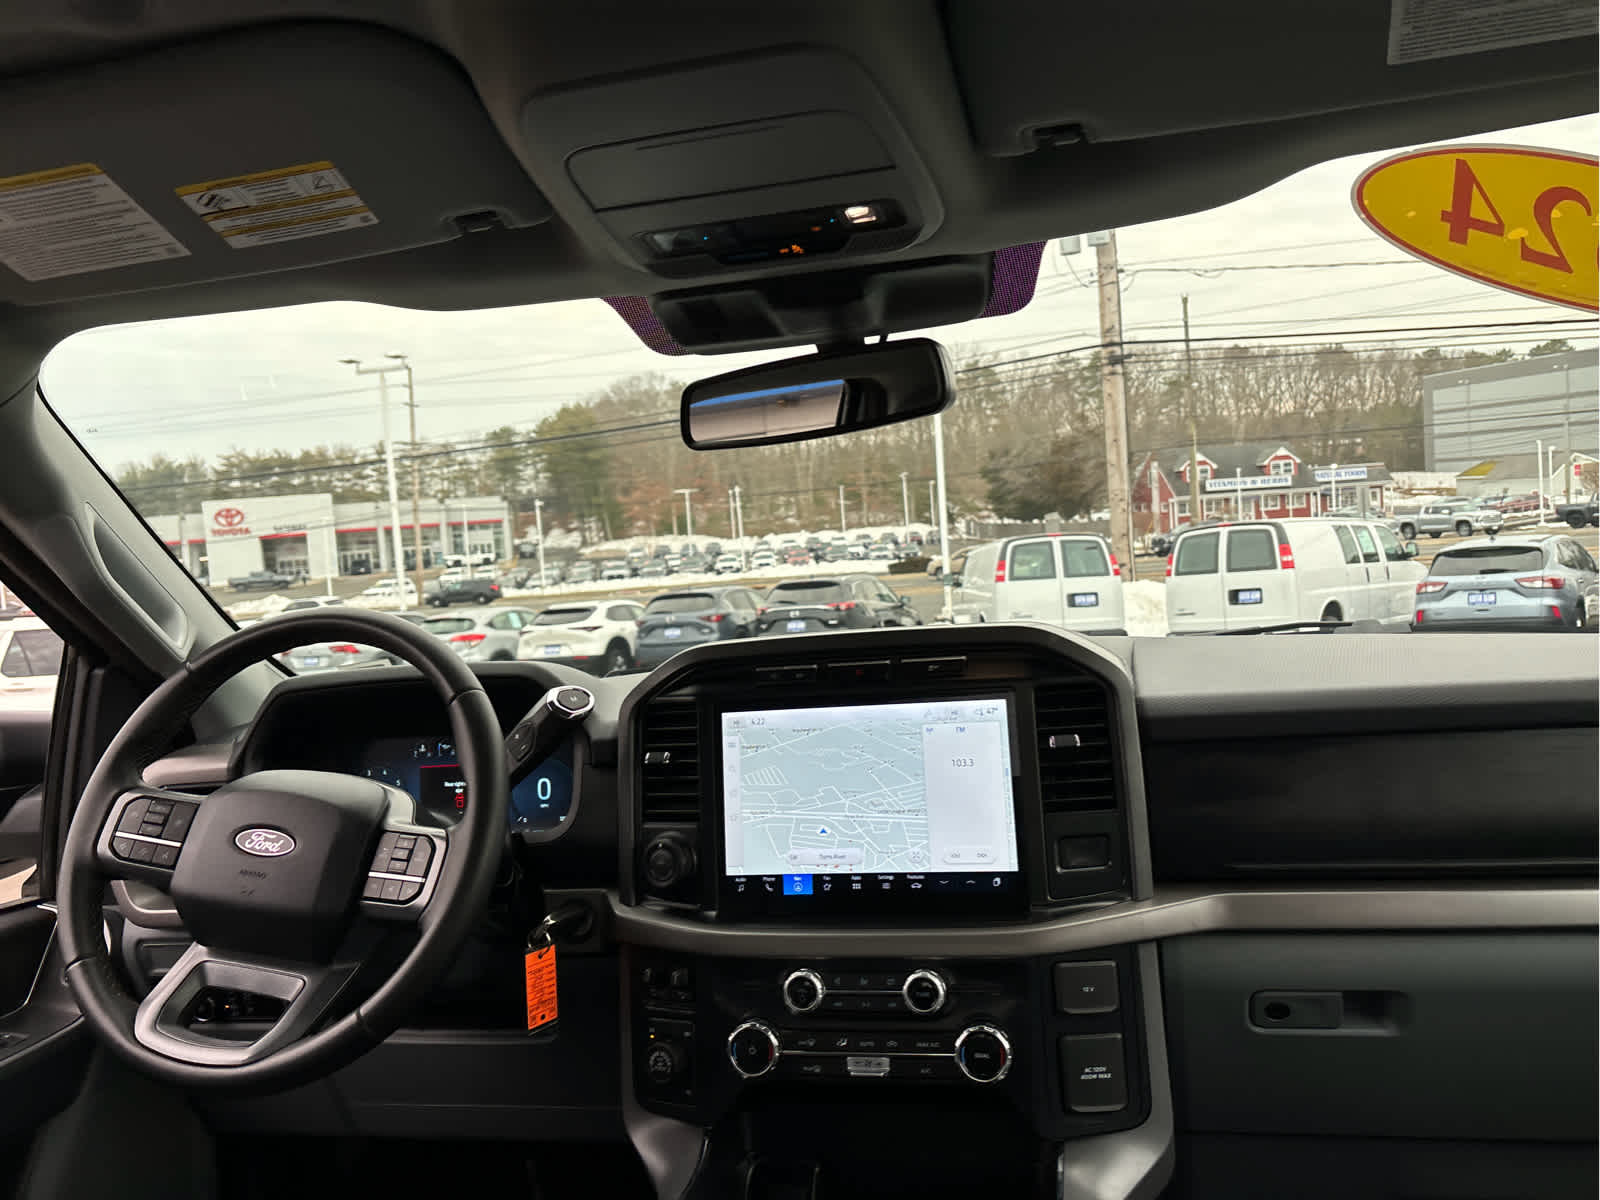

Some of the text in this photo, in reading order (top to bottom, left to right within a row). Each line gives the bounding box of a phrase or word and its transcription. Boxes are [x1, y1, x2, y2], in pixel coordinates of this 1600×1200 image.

[211, 527, 252, 536] TOYOTA
[951, 758, 975, 768] 103.3
[537, 777, 552, 801] 0
[243, 829, 286, 855] Ford
